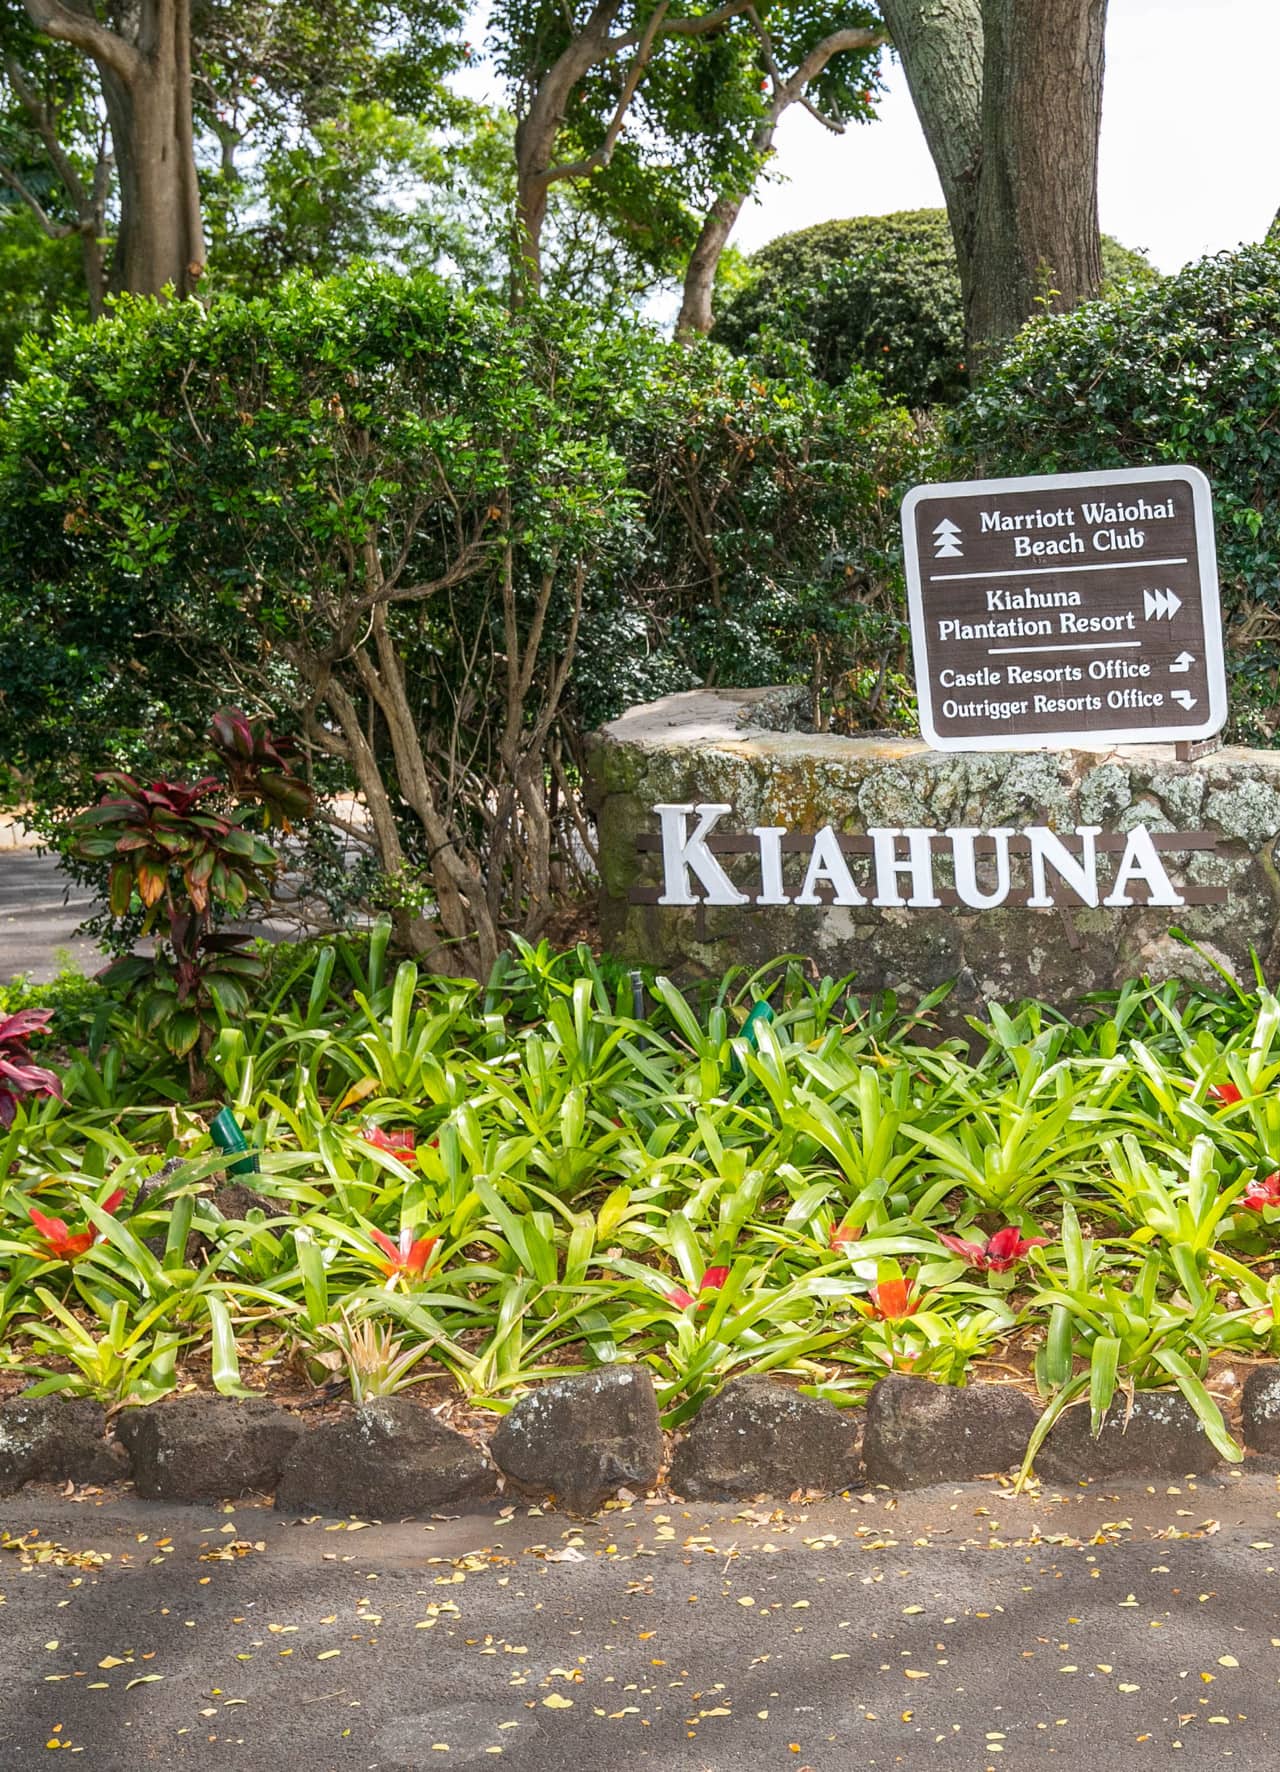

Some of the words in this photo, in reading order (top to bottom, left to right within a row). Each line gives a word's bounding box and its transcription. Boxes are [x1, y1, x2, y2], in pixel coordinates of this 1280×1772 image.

[980, 507, 1074, 533] Marriott
[1081, 499, 1175, 525] Waiohai
[1014, 533, 1084, 557] Beach
[1093, 528, 1145, 551] Club
[986, 588, 1081, 611] Kiahuna
[938, 615, 1052, 640] Plantation
[1059, 611, 1135, 634] Resort
[939, 666, 1000, 688] Castle
[1008, 664, 1082, 685] Resorts
[1088, 660, 1151, 679] Office
[942, 698, 1028, 719] Outrigger
[1034, 693, 1101, 714] Resorts
[1107, 690, 1164, 708] Office
[653, 803, 1186, 909] KIAHUNA
